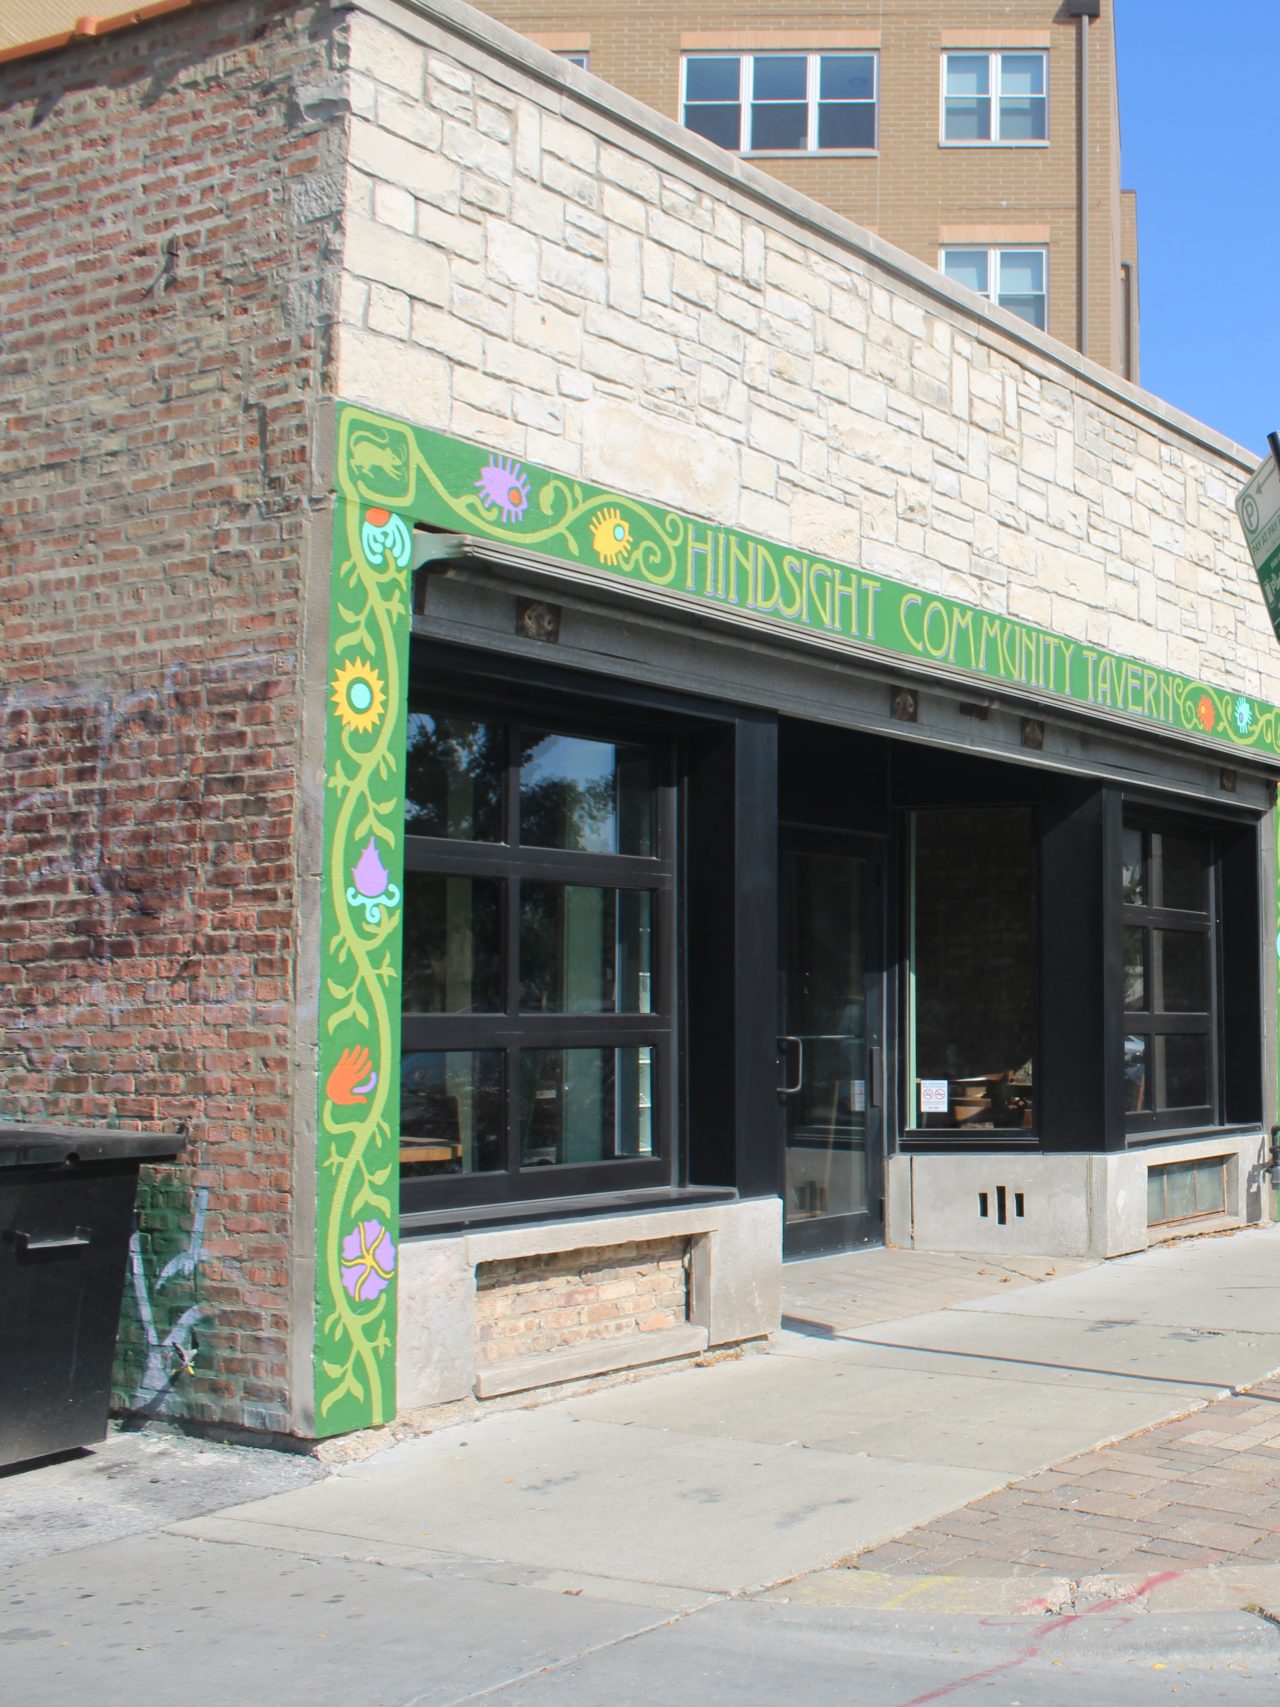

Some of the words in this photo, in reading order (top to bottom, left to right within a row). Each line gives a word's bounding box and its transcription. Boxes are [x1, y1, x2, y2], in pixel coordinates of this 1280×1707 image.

[1252, 537, 1263, 556] PAY
[1260, 530, 1269, 546] AT
[1267, 518, 1279, 538] PAY
[685, 523, 881, 640] HINDSIGHT
[900, 593, 1077, 695] COMMUNITY
[1082, 650, 1177, 725] TAVERN
